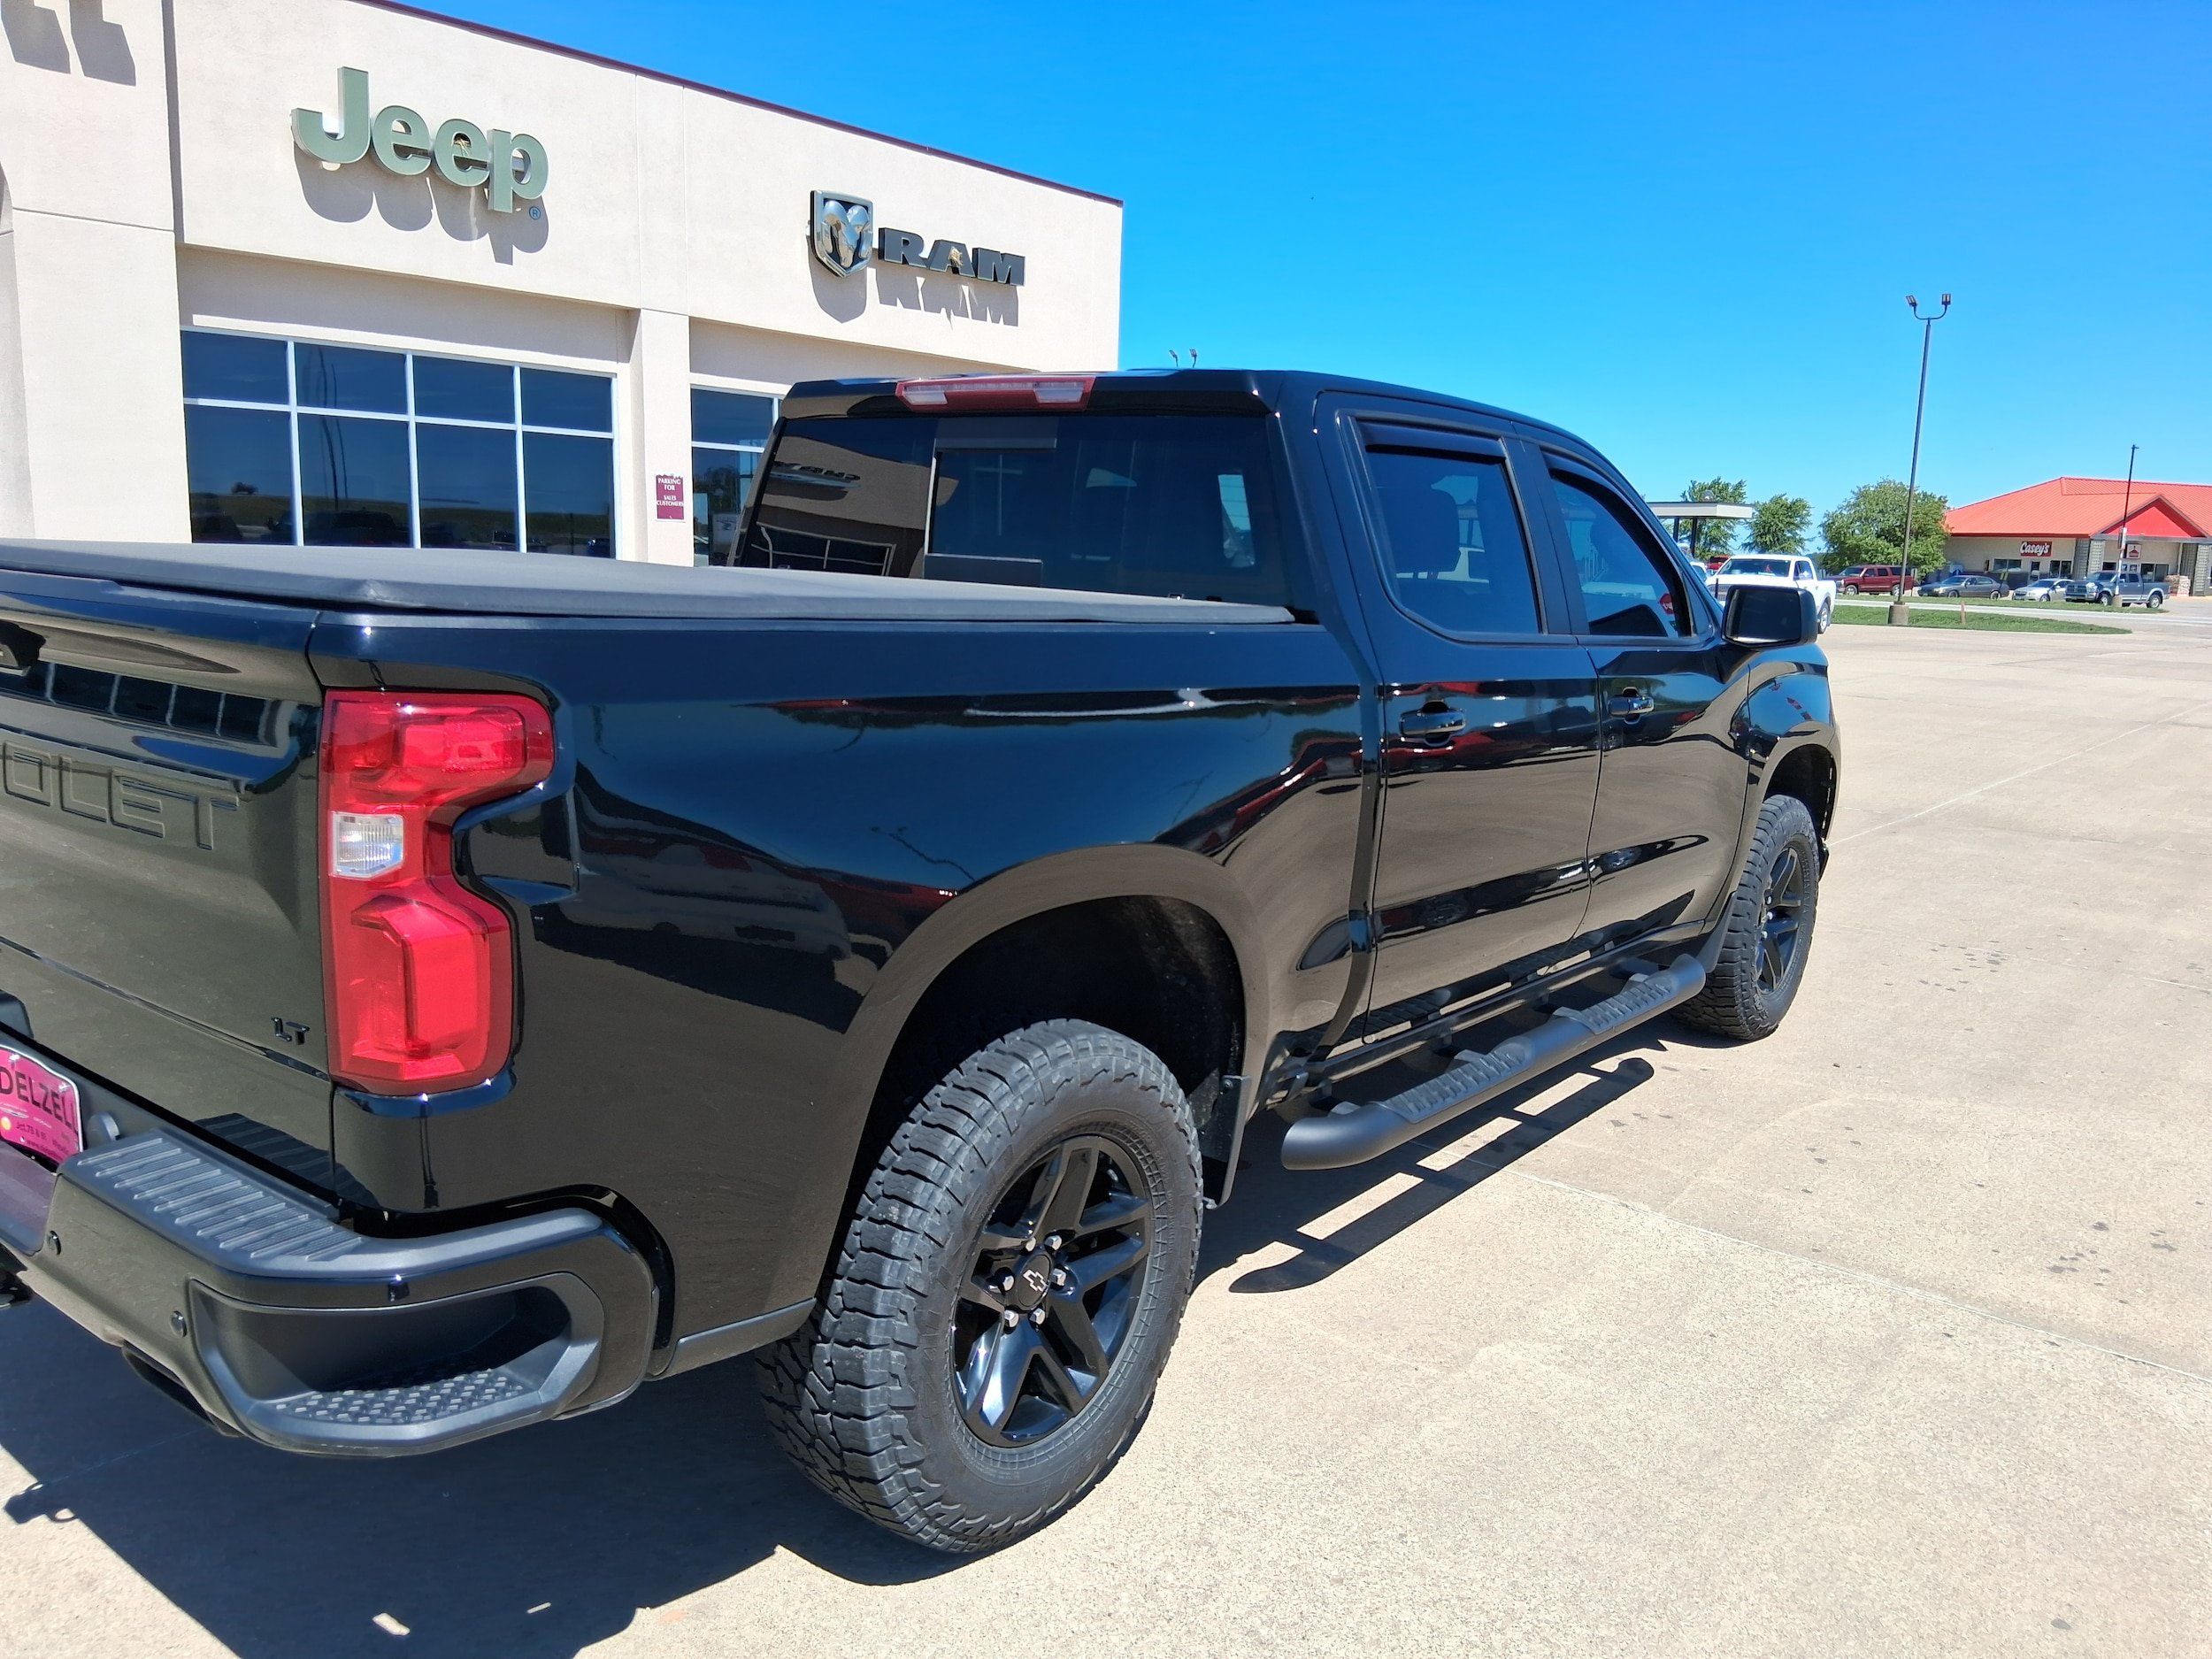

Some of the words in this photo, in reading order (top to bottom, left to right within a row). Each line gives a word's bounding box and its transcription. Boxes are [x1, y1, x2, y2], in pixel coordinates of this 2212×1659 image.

[291, 66, 549, 213] Jeep
[879, 227, 1025, 286] RAM
[2020, 541, 2050, 556] Casey's
[3, 741, 239, 850] OLET
[271, 1017, 311, 1045] LT
